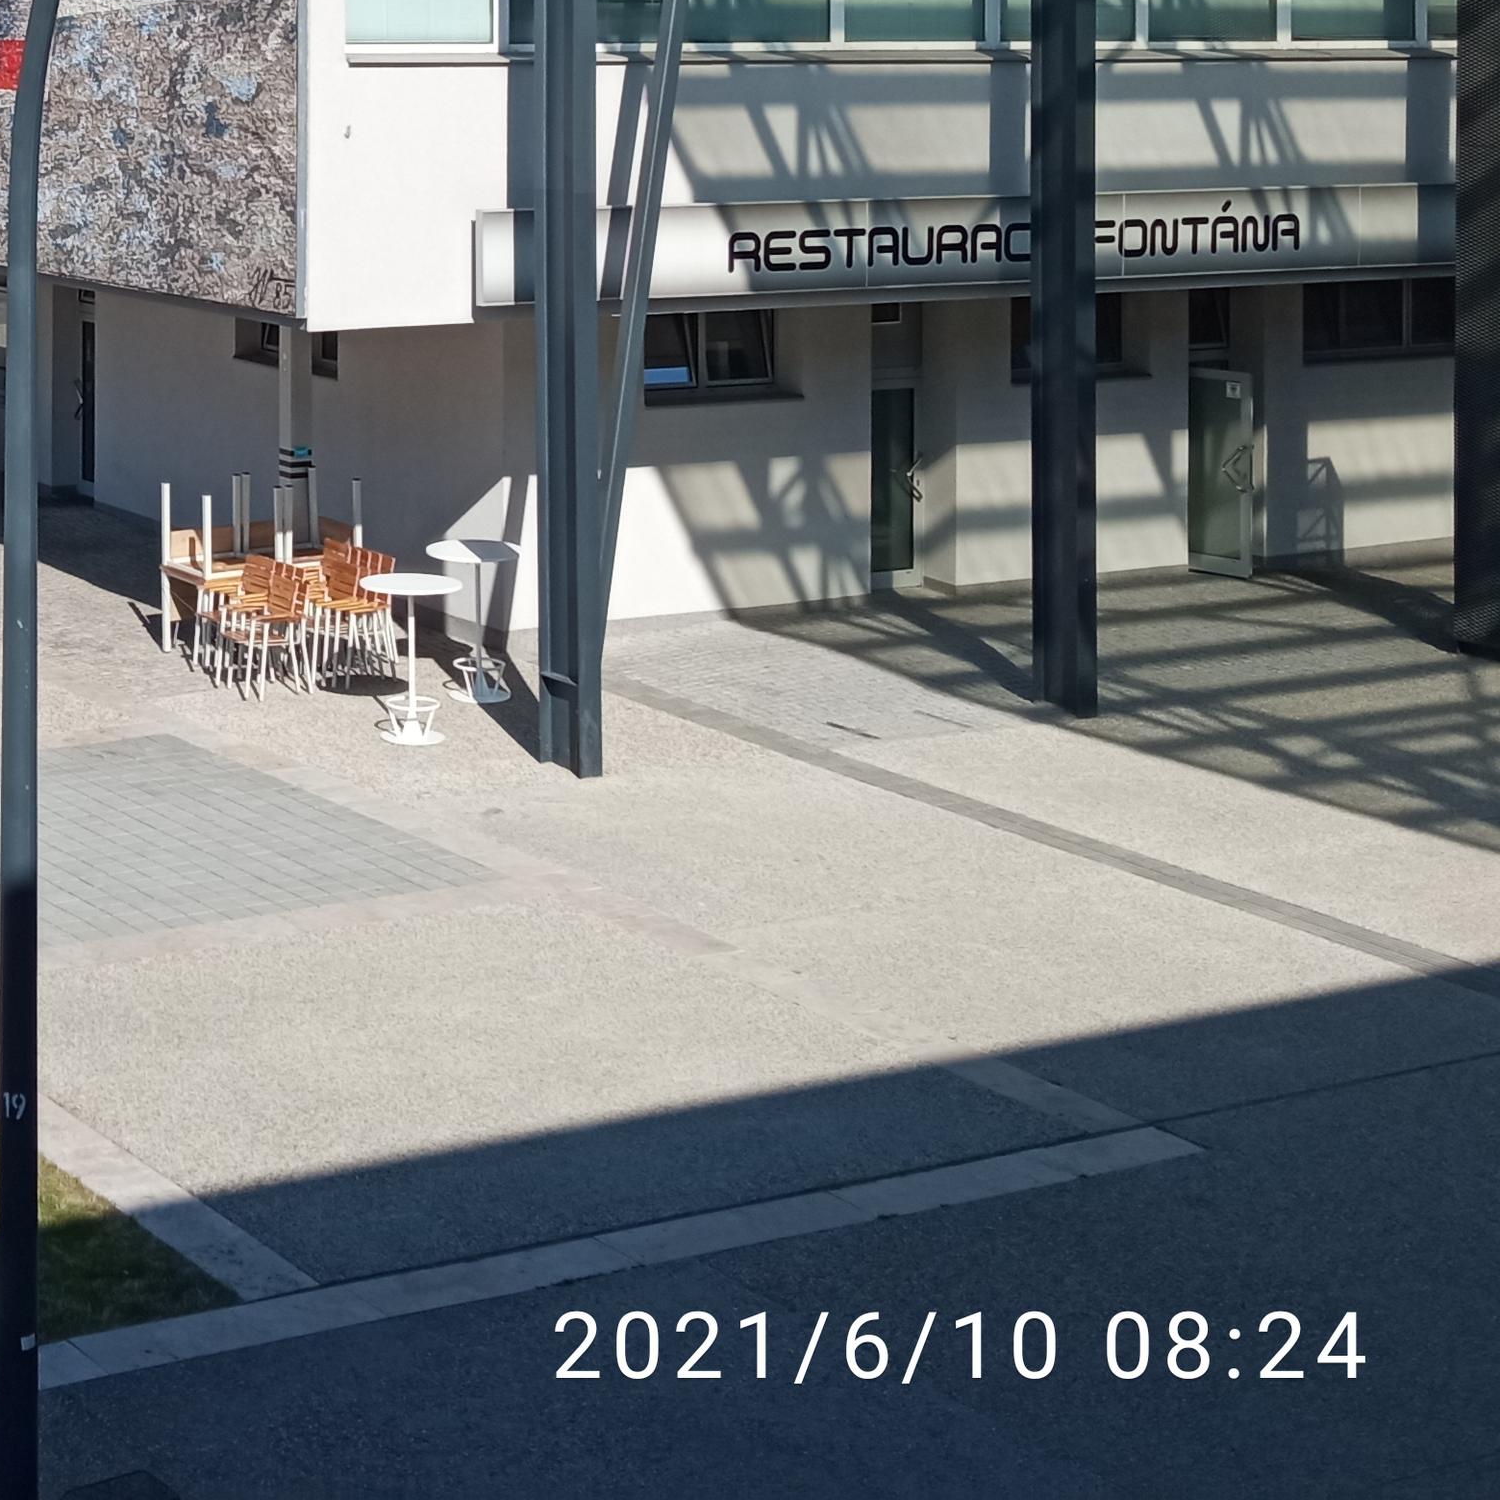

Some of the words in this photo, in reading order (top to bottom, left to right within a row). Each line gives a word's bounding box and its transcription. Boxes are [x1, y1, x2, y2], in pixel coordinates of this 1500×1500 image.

[728, 222, 1032, 274] RESTAURAC
[1094, 199, 1300, 258] FONTÁNA
[3, 1091, 26, 1120] 19
